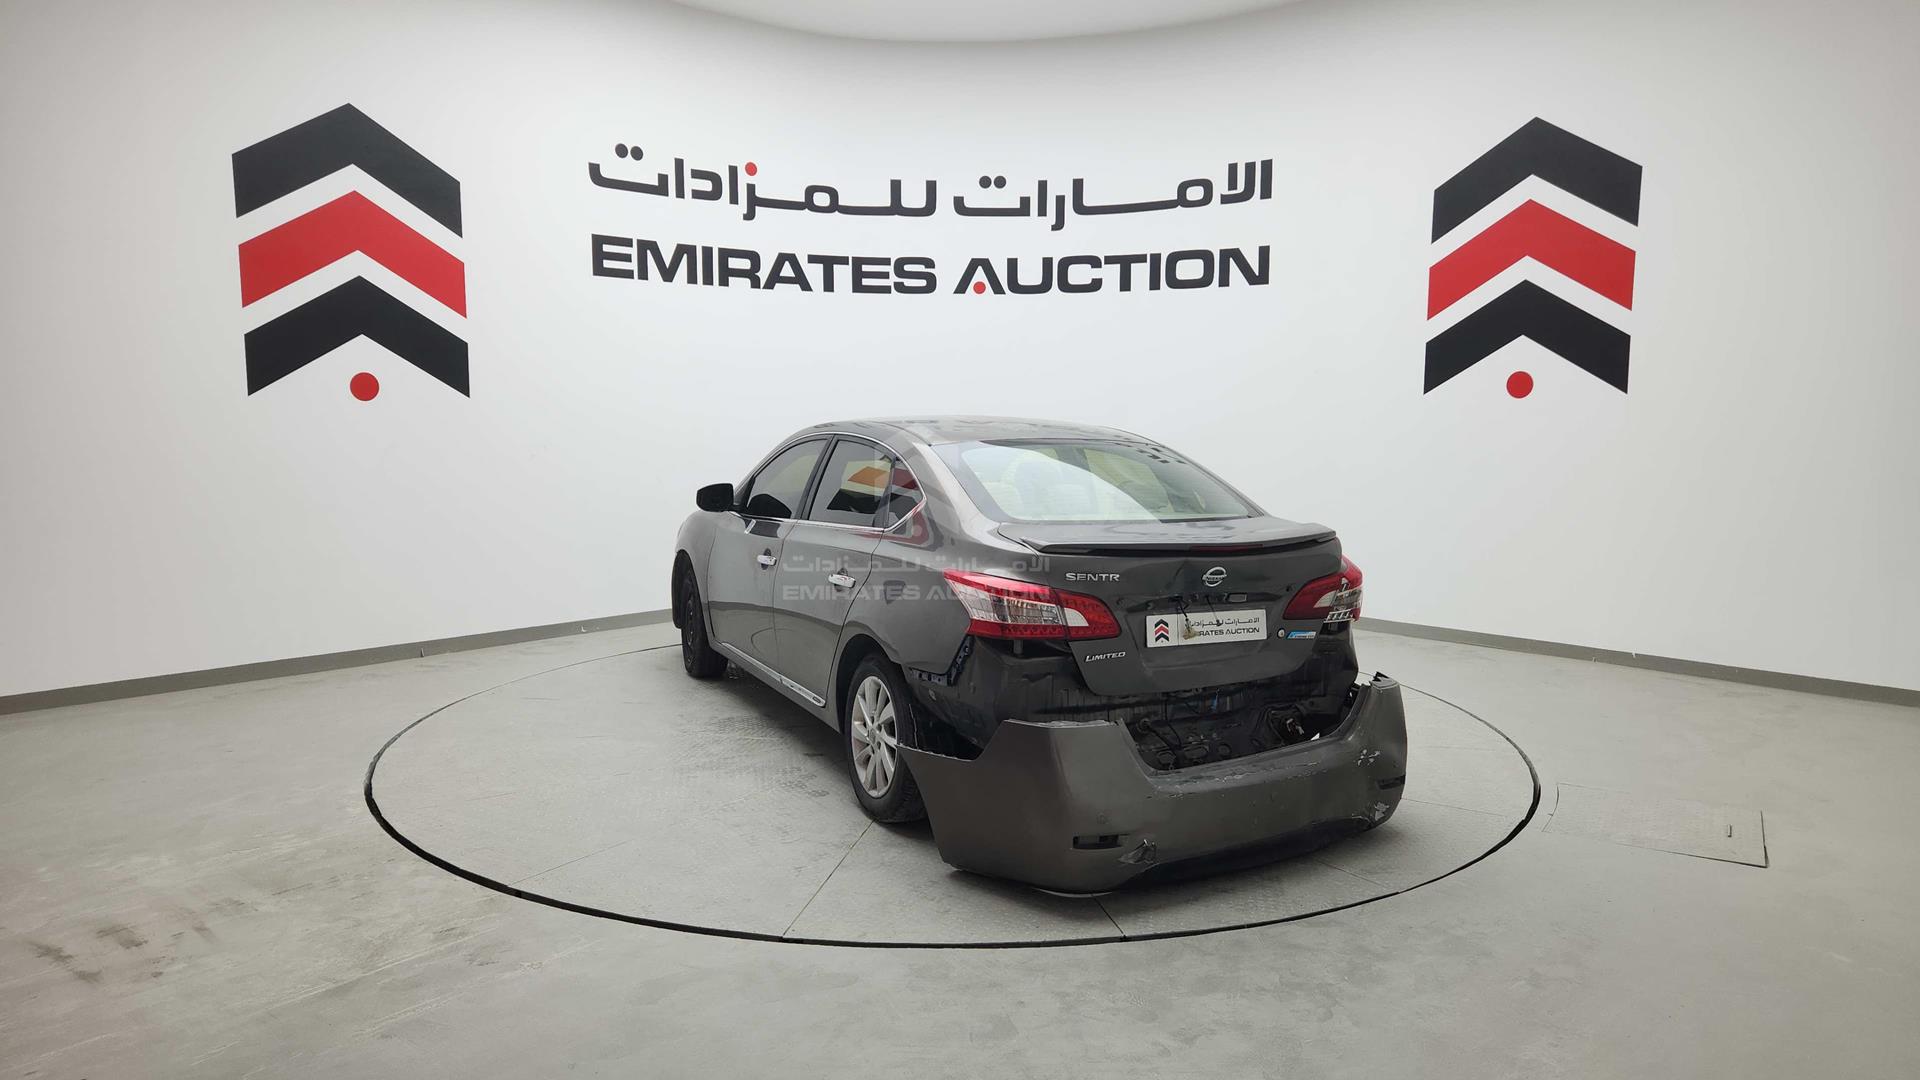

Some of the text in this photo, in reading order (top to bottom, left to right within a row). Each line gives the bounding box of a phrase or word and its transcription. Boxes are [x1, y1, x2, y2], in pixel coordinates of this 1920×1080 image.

[588, 143, 1272, 231] الامارات للمزادات
[591, 234, 1271, 295] EMIRATES AUCTION
[1065, 572, 1120, 582] SENTR
[1225, 627, 1260, 636] AUCTION
[1085, 651, 1127, 663] LIMITED
